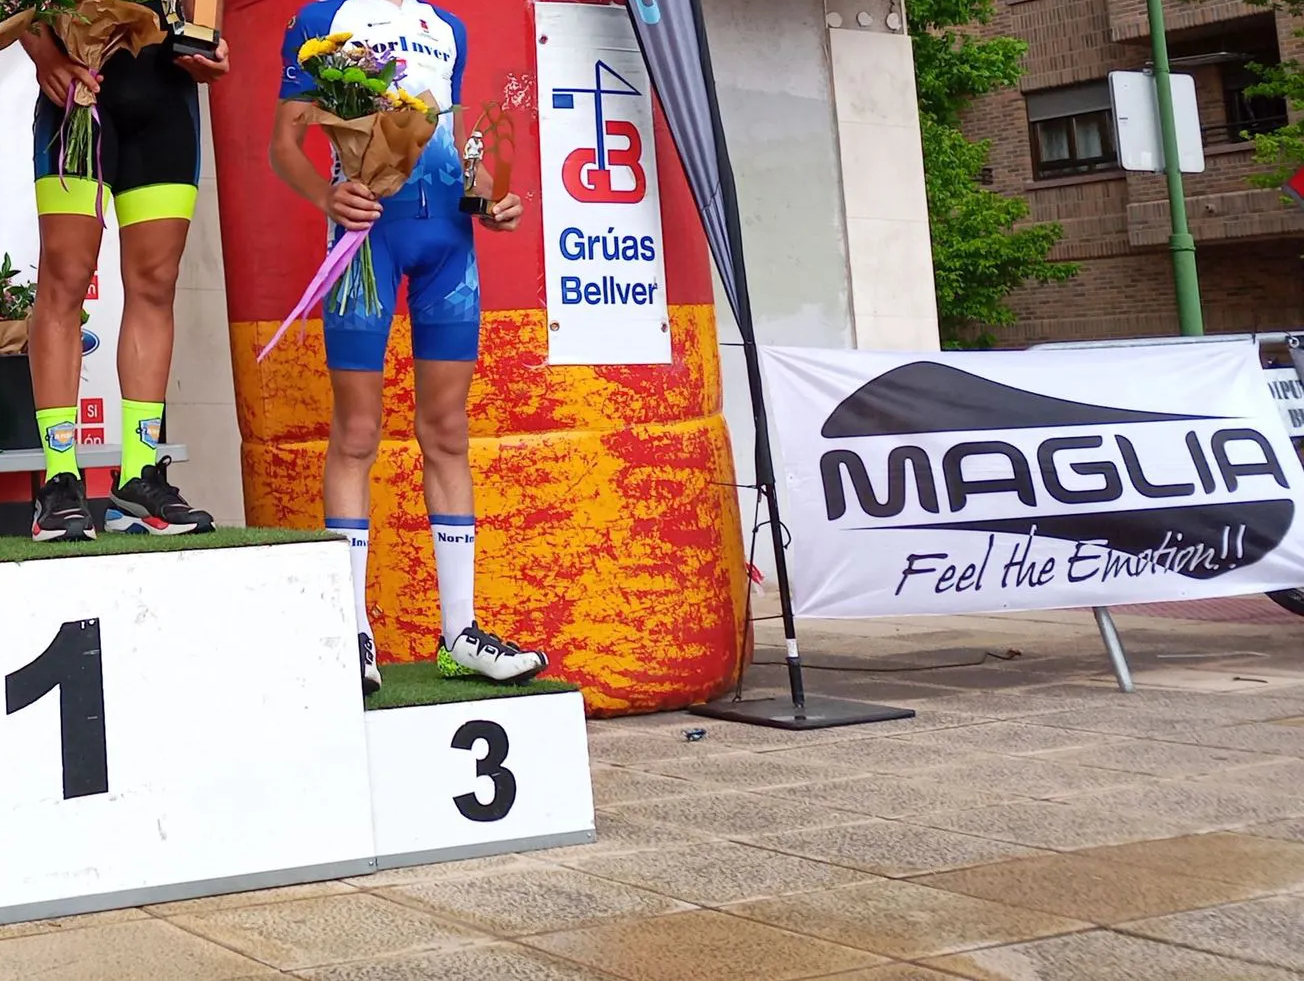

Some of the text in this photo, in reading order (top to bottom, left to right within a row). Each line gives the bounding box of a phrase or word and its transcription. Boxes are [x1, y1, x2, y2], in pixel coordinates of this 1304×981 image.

[559, 226, 656, 262] Grúas
[560, 276, 658, 306] Bellver
[819, 427, 1291, 521] MAGLIA
[894, 522, 1247, 598] Feel the Emotion!!
[5, 617, 109, 801] 1
[450, 720, 517, 823] 3
